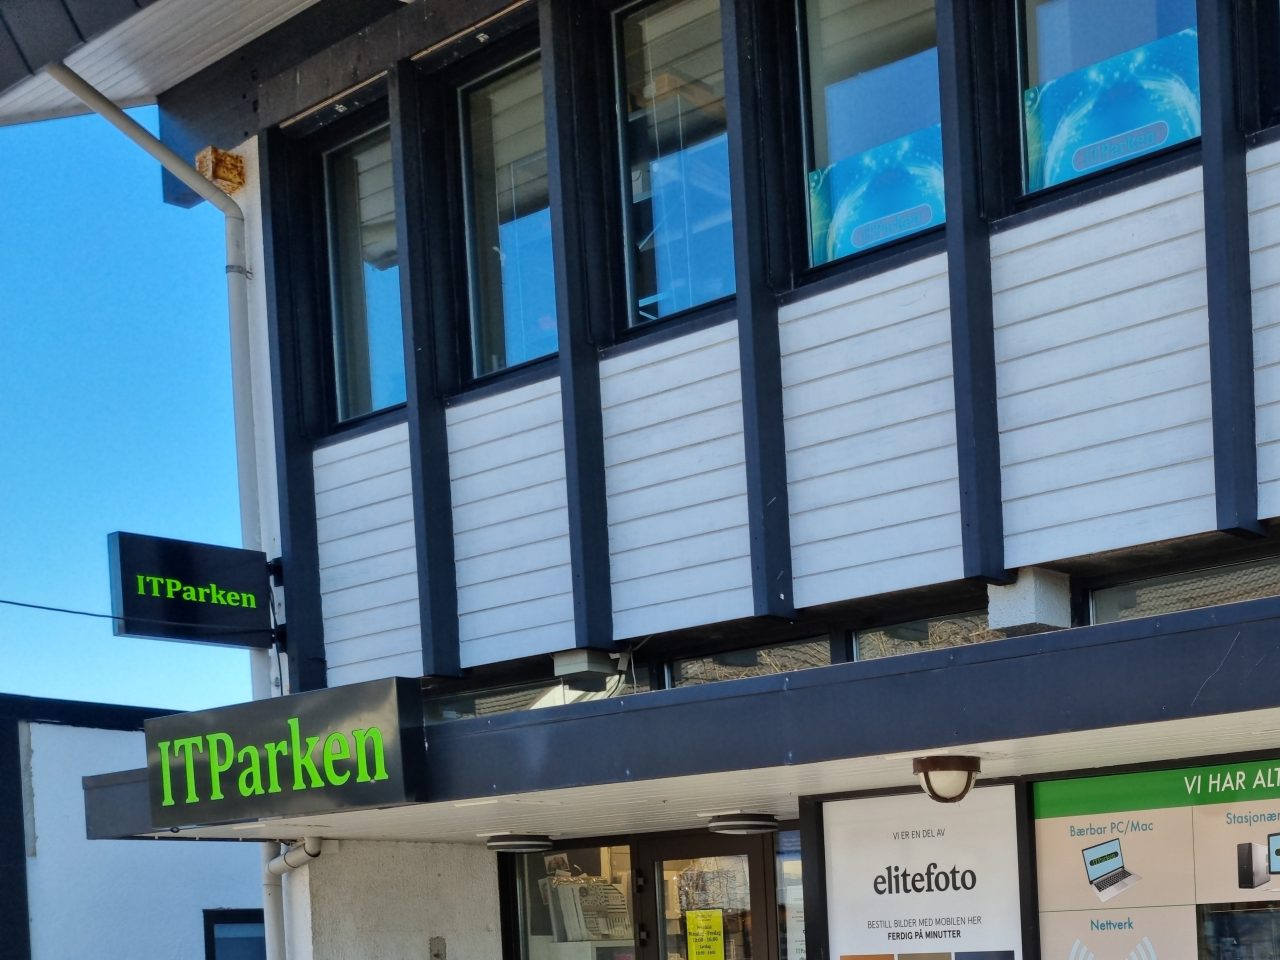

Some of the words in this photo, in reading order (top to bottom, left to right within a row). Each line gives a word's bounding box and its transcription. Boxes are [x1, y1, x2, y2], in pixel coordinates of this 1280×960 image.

[136, 575, 257, 609] ITParken
[158, 717, 389, 807] ITParken
[1184, 775, 1201, 795] VI
[1209, 772, 1246, 793] HAR
[893, 831, 900, 841] VI
[901, 831, 910, 840] ER
[911, 830, 921, 840] EN
[922, 829, 935, 839] DEL
[935, 828, 946, 838] AV
[1070, 824, 1107, 837] Bærbar
[1110, 820, 1154, 835] PC/Mac
[873, 862, 977, 895] elitefoto
[867, 919, 892, 930] BESTILL
[894, 918, 919, 929] BILDER
[920, 917, 934, 927] MED
[935, 916, 966, 927] MOBILEN
[967, 915, 982, 925] HER
[1090, 918, 1134, 931] Nettverk
[887, 931, 914, 941] FERDIG
[915, 929, 924, 940] PÅ
[925, 929, 962, 940] MINUTTER
